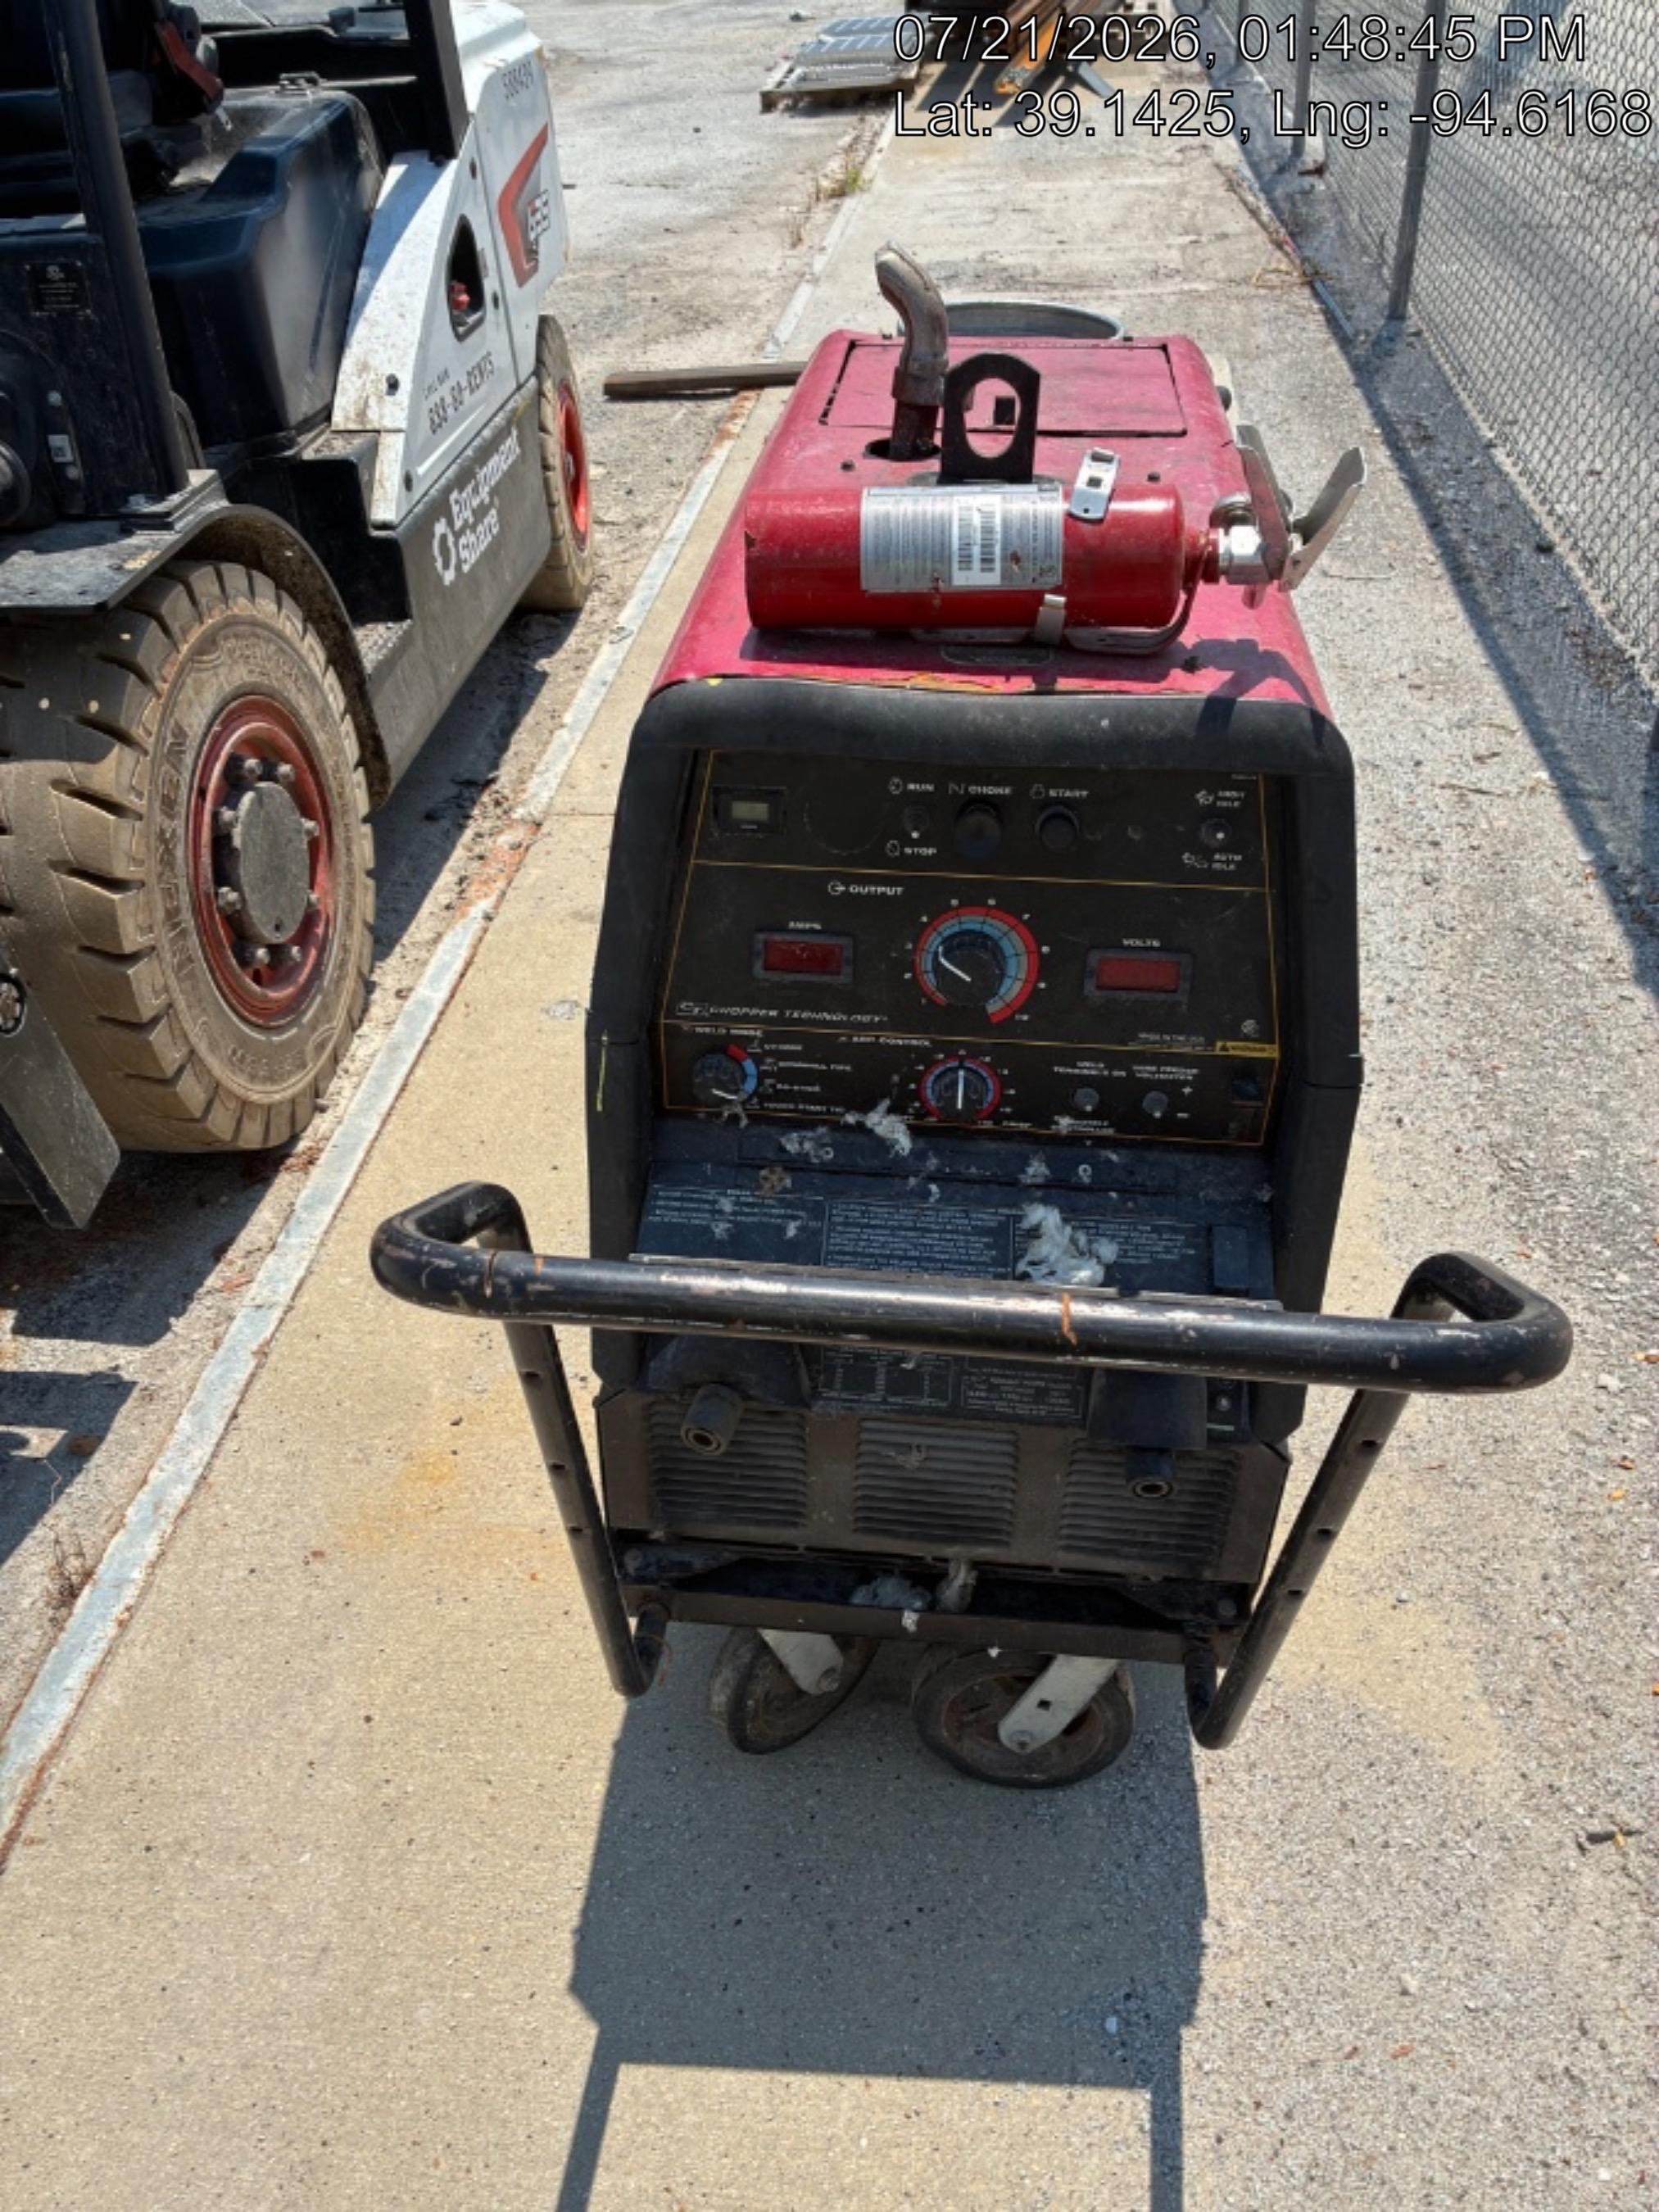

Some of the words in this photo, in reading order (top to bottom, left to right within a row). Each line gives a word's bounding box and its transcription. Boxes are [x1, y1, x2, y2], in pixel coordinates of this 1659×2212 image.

[449, 424, 521, 532] Equipment
[459, 507, 500, 574] Share
[968, 785, 1013, 795] CHOKE
[1048, 788, 1090, 797] START
[849, 883, 904, 897] OUTPUT
